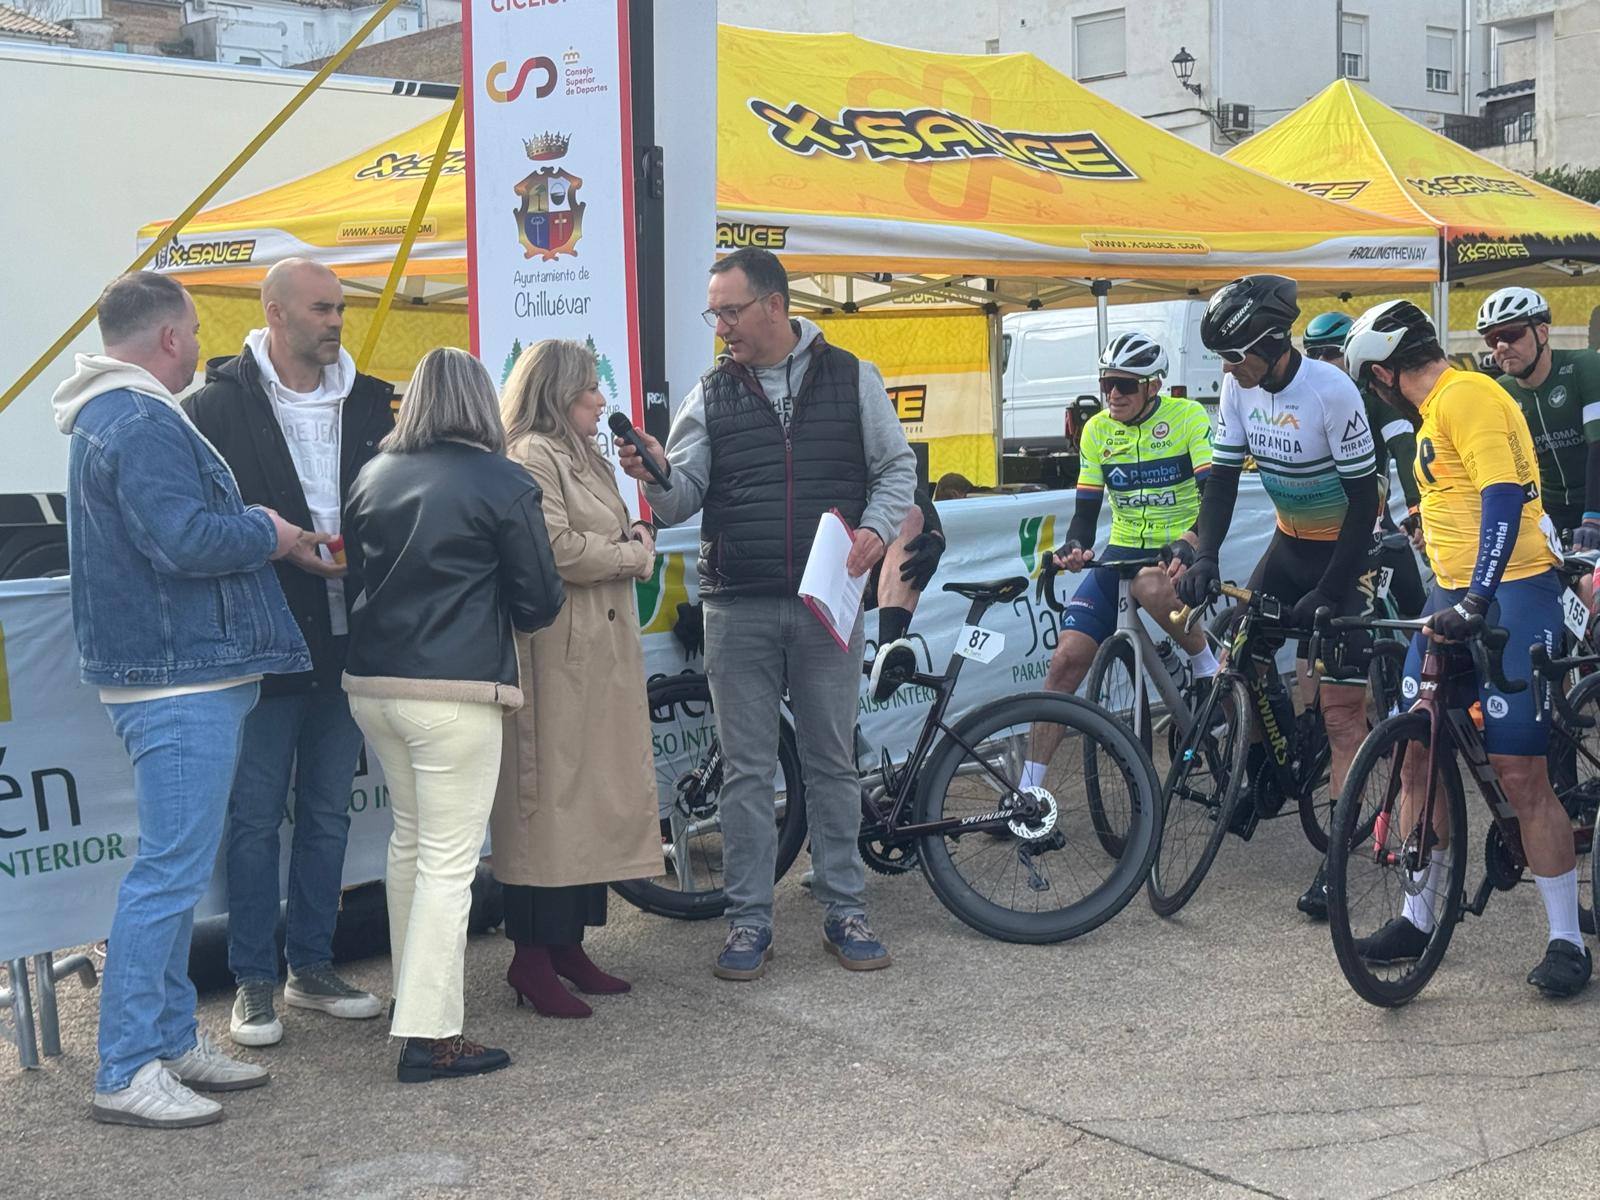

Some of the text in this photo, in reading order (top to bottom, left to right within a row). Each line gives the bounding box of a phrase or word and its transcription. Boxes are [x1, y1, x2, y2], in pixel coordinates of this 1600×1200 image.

[565, 66, 593, 79] Consejo
[566, 76, 595, 88] Superior
[565, 85, 608, 96] de Deportes
[748, 98, 1137, 178] X-SAUCE
[1405, 175, 1536, 198] X-SAUCE
[342, 225, 432, 237] WWW.X-SAUCEOM
[716, 223, 789, 249] AUCE
[169, 240, 256, 267] X-SAUCE
[1348, 246, 1427, 260] #ROLLINGTHEWAY
[1458, 242, 1530, 264] X-SAUCE
[513, 266, 590, 289] Ayuntamiento de
[514, 290, 591, 318] Chilluévar
[646, 392, 668, 411] RCA
[1248, 431, 1303, 454] MIRANDA
[1341, 435, 1372, 454] MIRAN
[1481, 521, 1509, 588] Areva Dental
[1568, 596, 1586, 626] 155
[969, 629, 990, 650] 87
[1012, 654, 1051, 684] PARAÍ
[0, 833, 127, 878] NTERIOR
